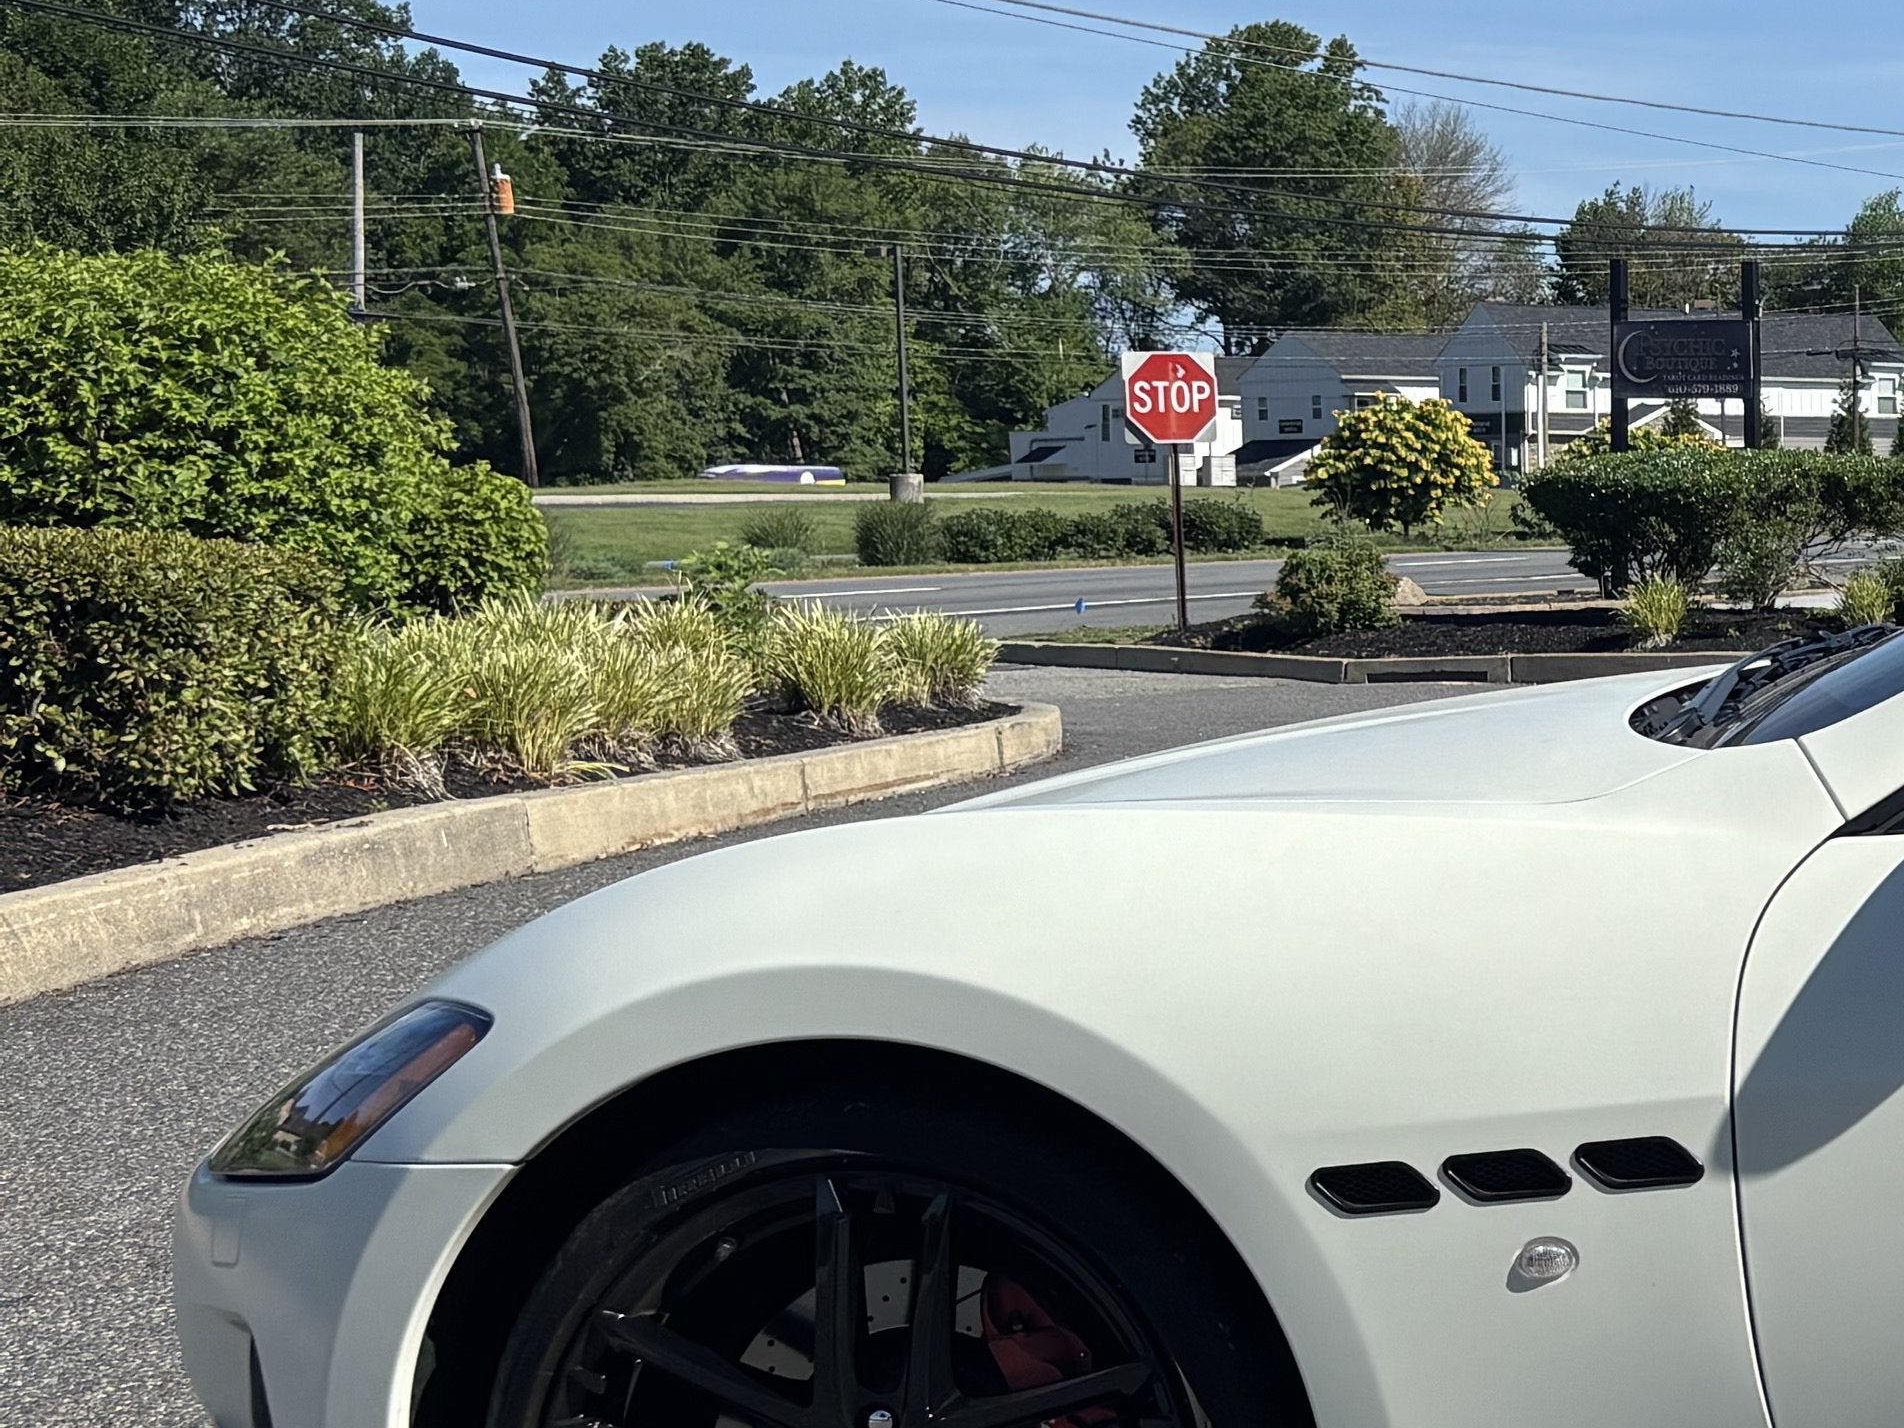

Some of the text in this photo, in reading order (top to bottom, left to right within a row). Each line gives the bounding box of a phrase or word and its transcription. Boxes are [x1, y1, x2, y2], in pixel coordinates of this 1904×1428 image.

[1638, 333, 1726, 357] PSYCHIC
[1645, 357, 1719, 372] BOUTIQUE
[1662, 372, 1684, 382] TAROT
[1687, 373, 1706, 382] CARD
[1132, 379, 1212, 414] STOP
[1667, 383, 1740, 395] 610-579-1889
